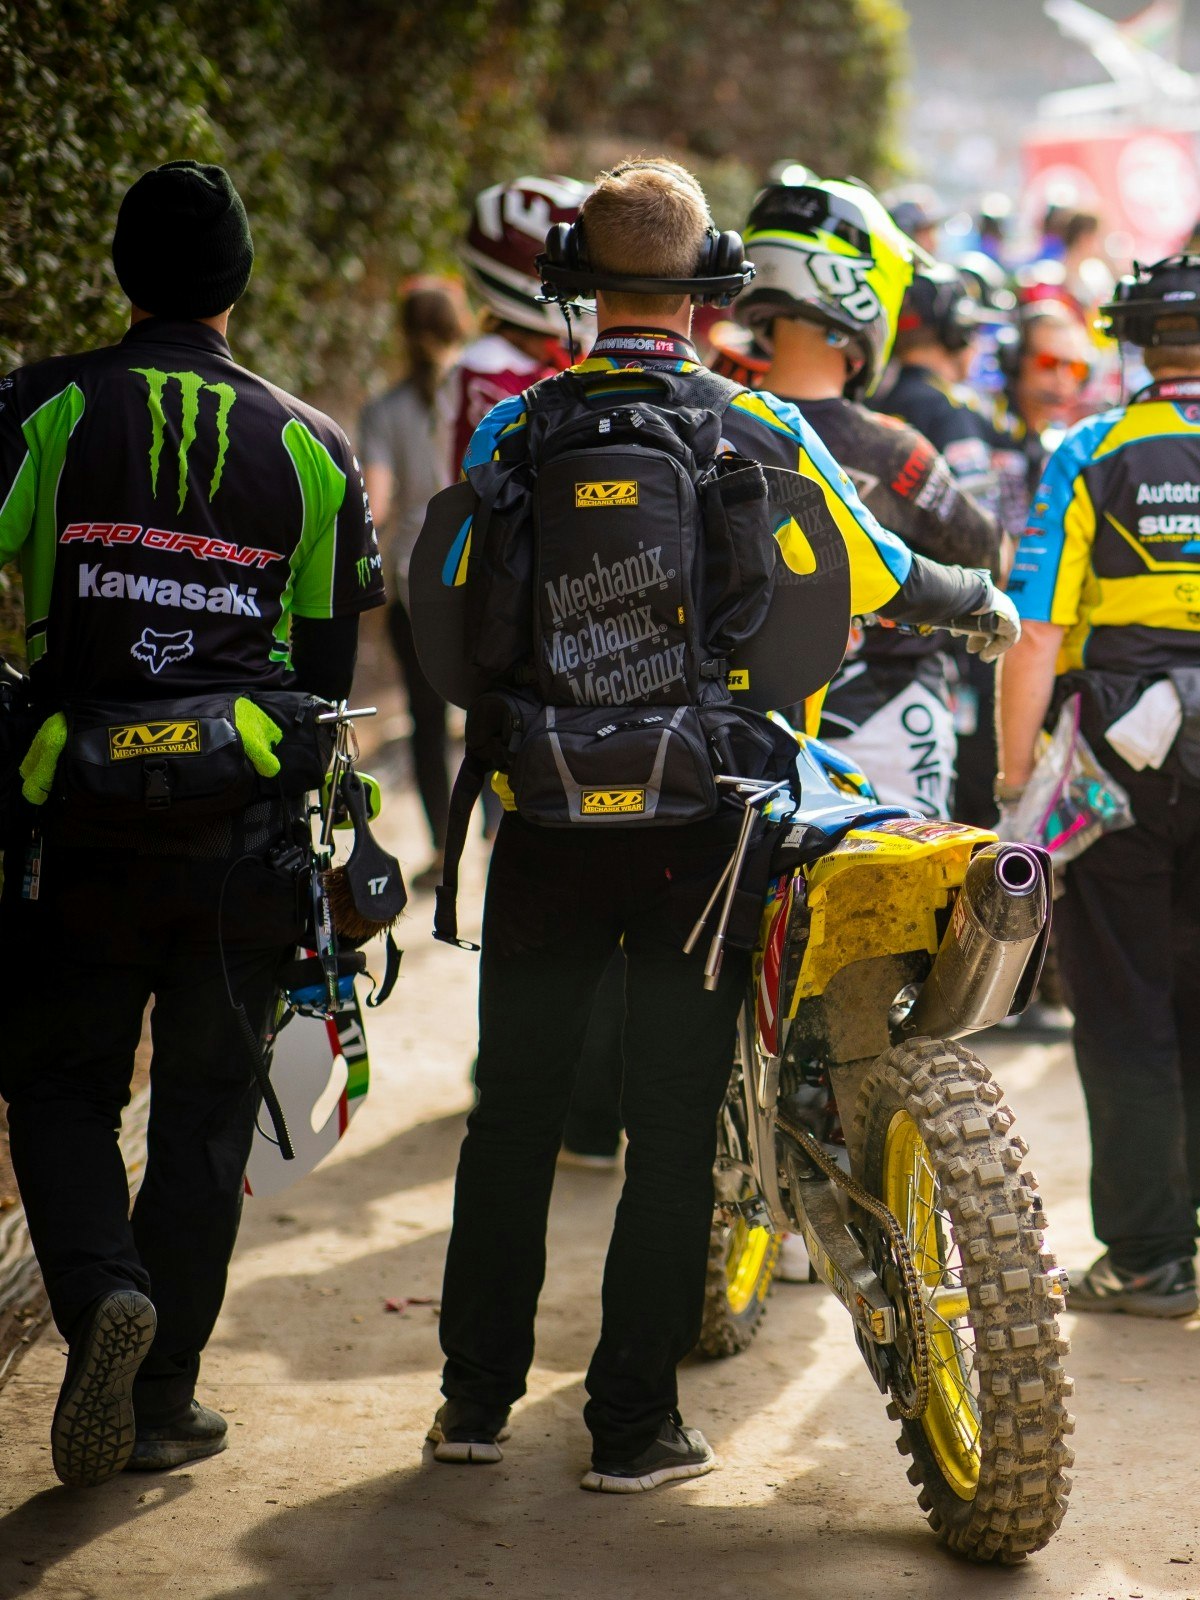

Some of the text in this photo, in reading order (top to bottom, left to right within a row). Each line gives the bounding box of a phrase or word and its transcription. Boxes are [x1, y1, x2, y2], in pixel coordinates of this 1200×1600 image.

[59, 523, 285, 569] PRO CIRCUIT
[79, 563, 262, 618] Kawasaki
[545, 541, 667, 624] Mechanix
[113, 741, 198, 758] MECHANIX WEAR
[621, 803, 641, 811] WEAR
[368, 876, 389, 896] 17
[338, 1018, 368, 1058] 17
